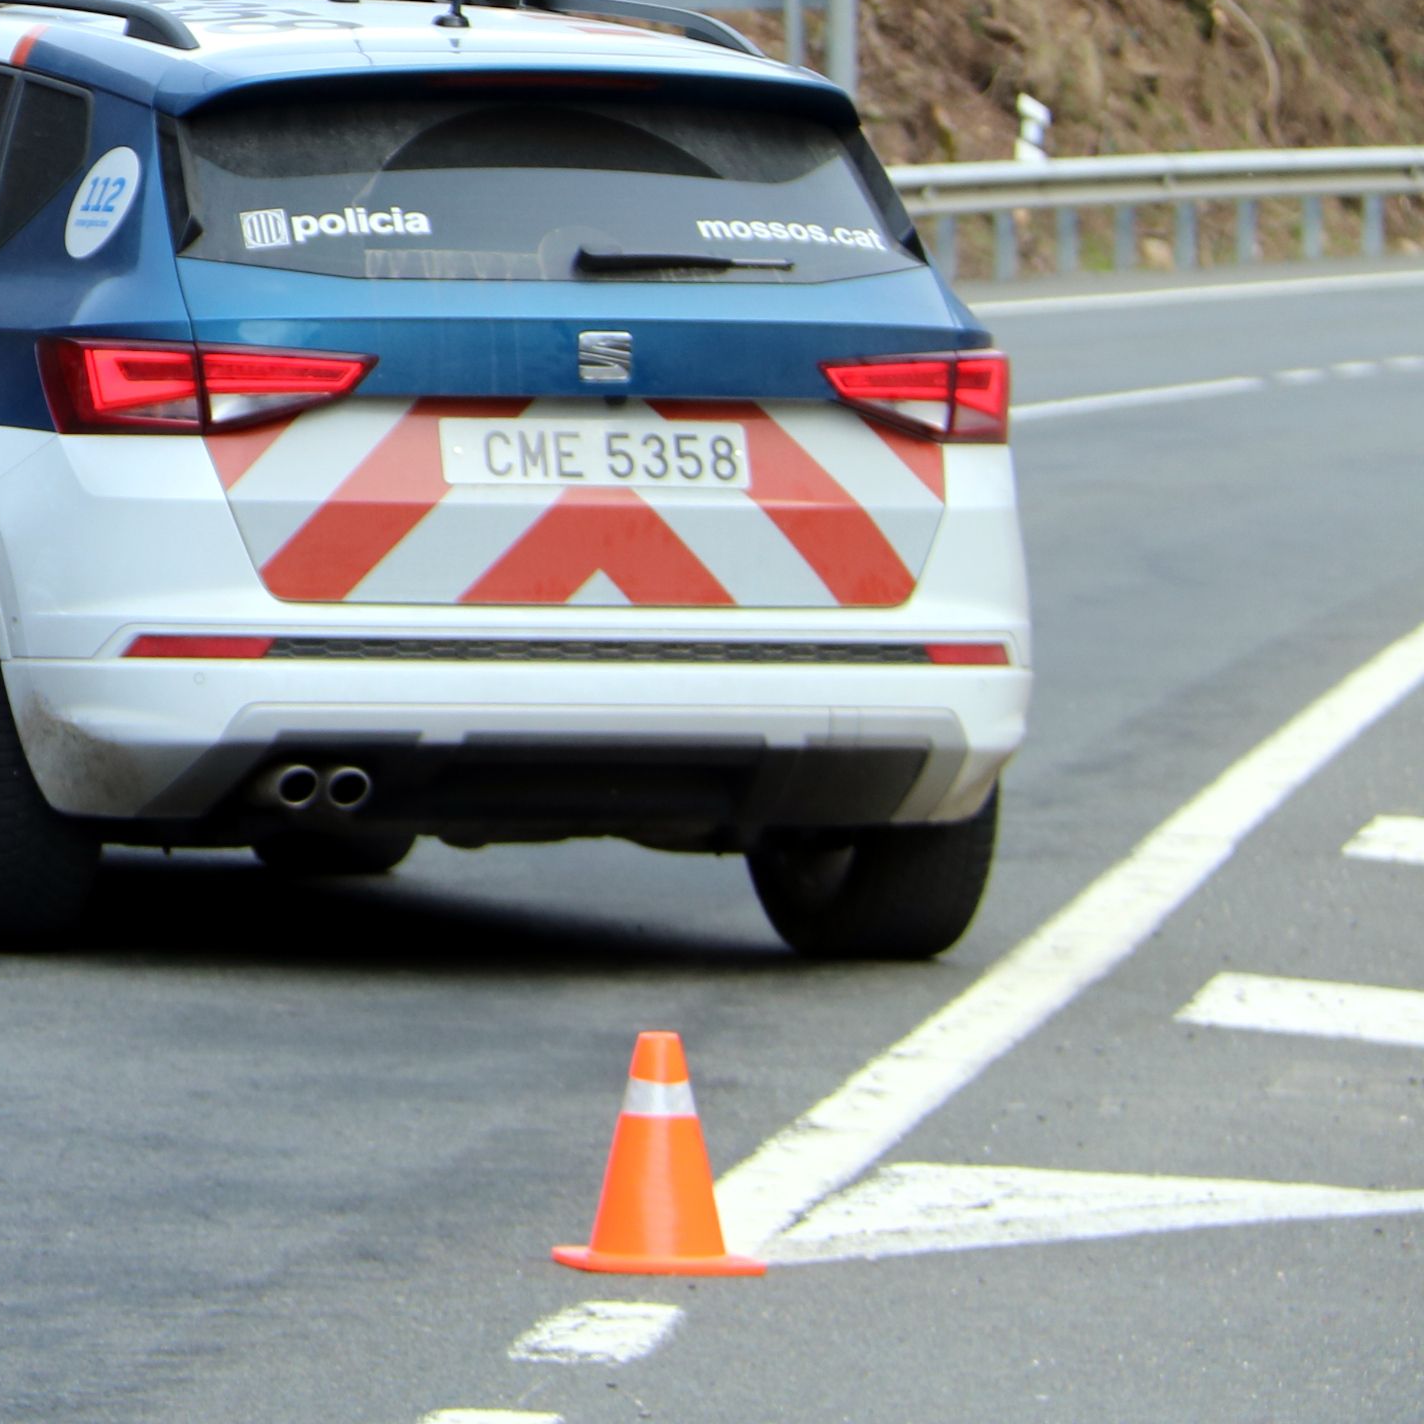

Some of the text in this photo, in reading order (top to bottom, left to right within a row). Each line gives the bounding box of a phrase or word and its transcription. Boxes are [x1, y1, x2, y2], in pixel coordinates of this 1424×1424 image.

[80, 176, 126, 212] 112
[291, 207, 432, 243] policia
[696, 219, 887, 252] mossos.cat
[483, 430, 737, 481] CME 5358
